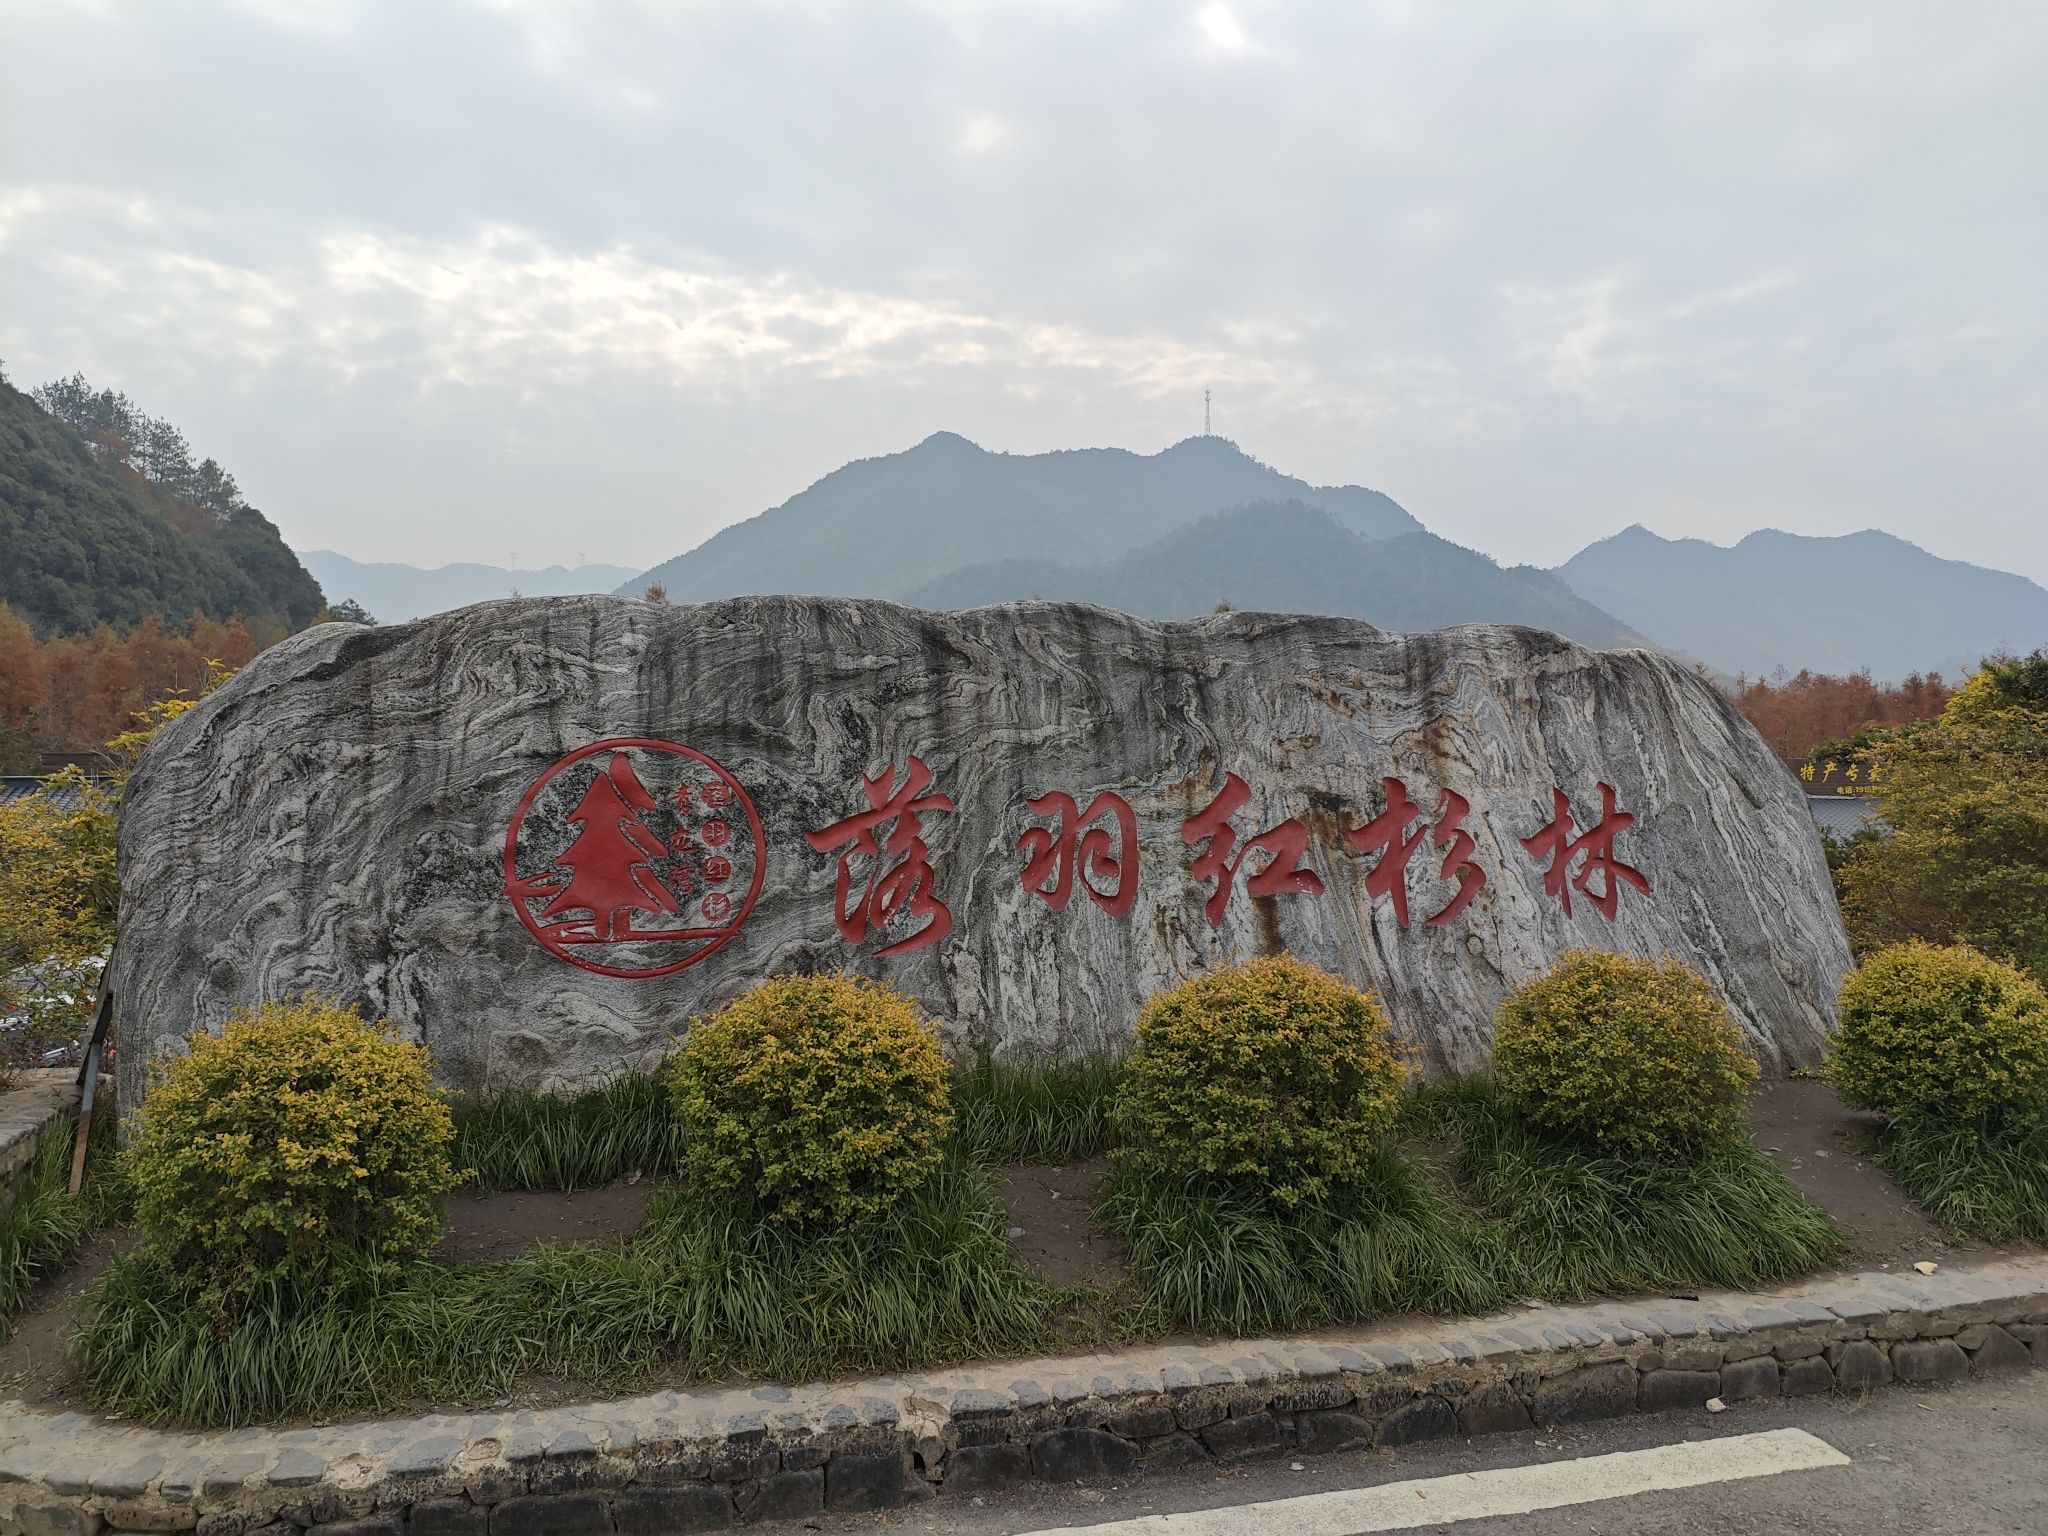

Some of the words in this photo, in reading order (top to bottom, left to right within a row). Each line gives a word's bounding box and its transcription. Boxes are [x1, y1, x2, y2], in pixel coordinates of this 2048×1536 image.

[804, 756, 1653, 957] 落羽红杉林
